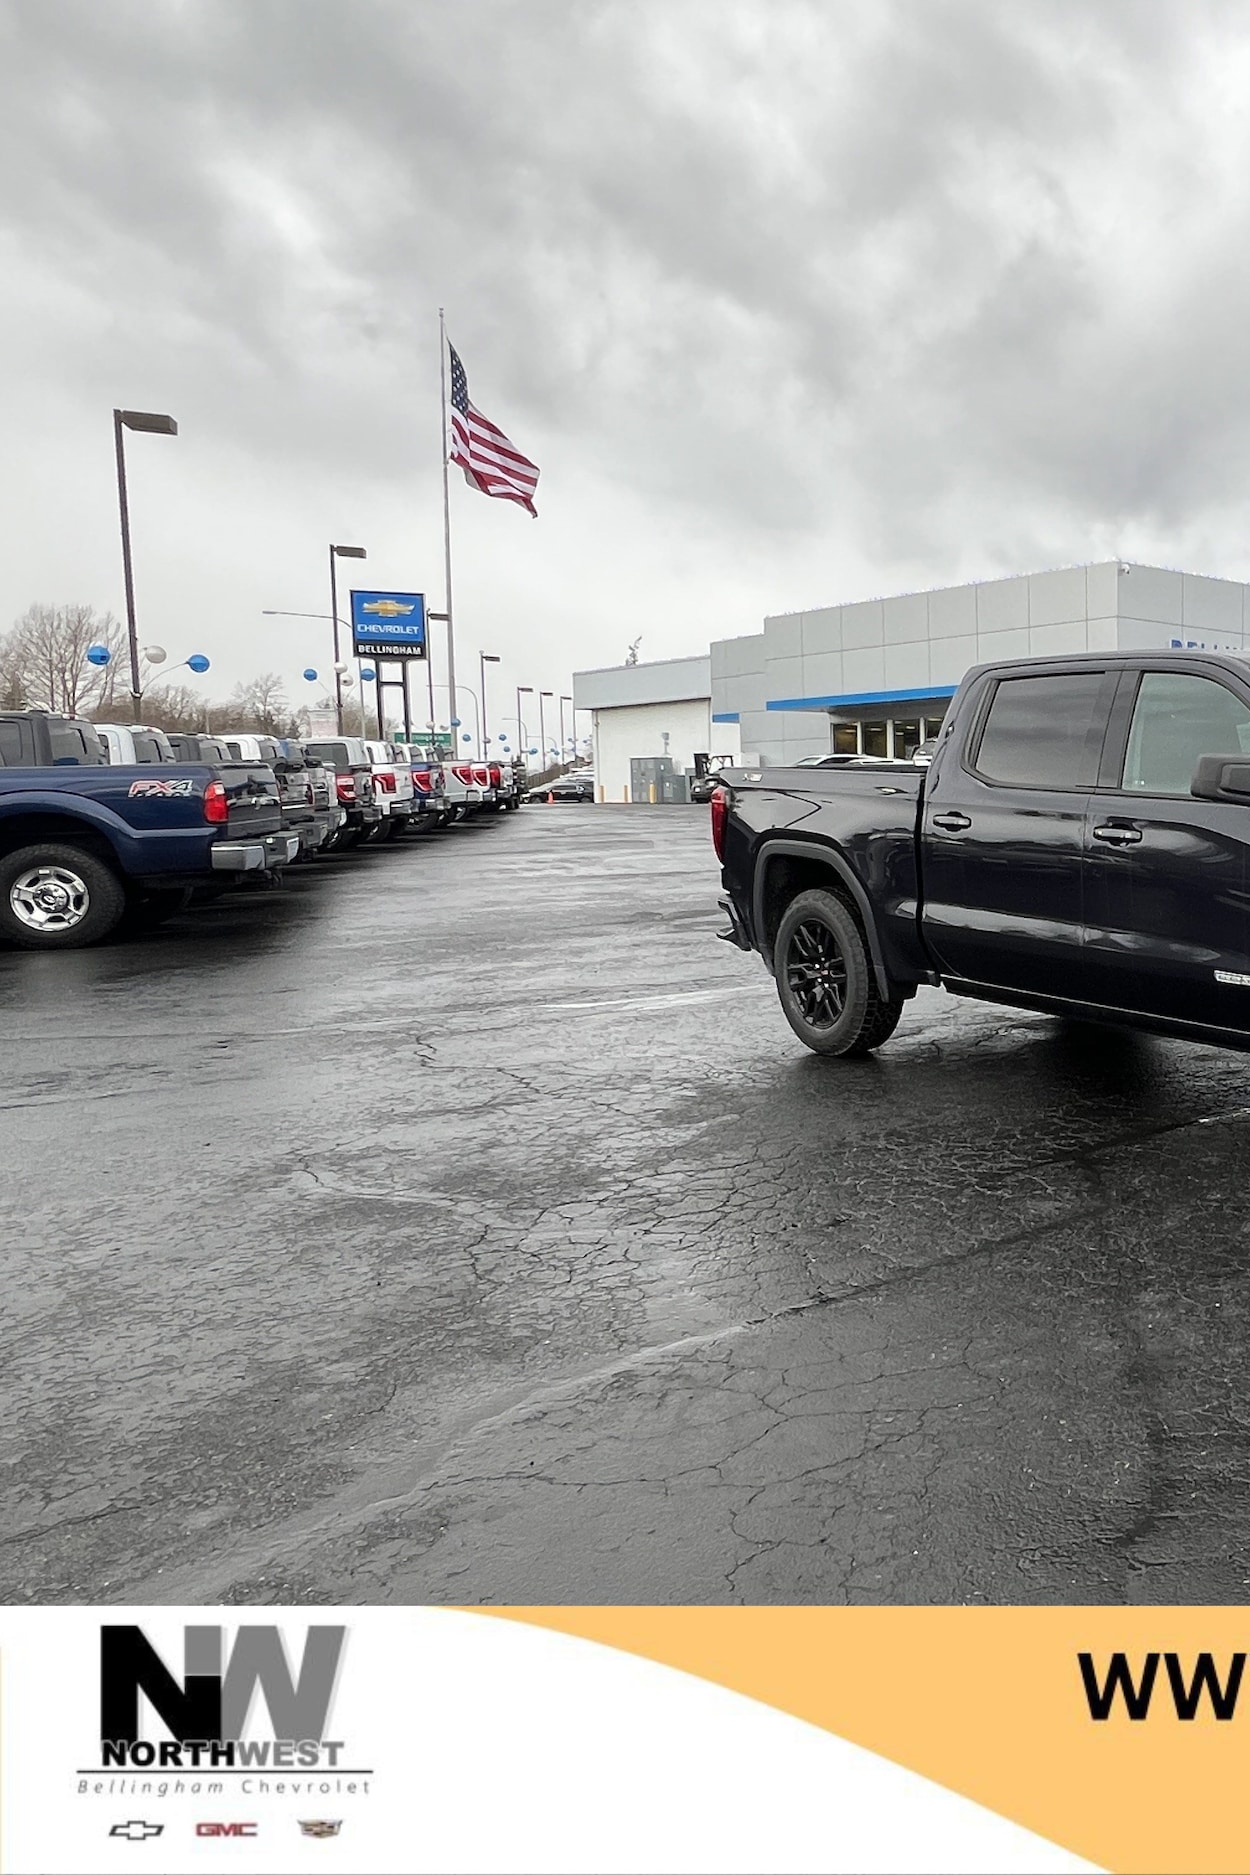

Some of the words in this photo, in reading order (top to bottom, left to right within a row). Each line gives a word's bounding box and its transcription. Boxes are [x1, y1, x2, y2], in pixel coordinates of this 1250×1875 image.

[357, 624, 419, 635] CHEVROLET
[358, 645, 421, 655] BELLINGHAM
[128, 779, 193, 797] FX4
